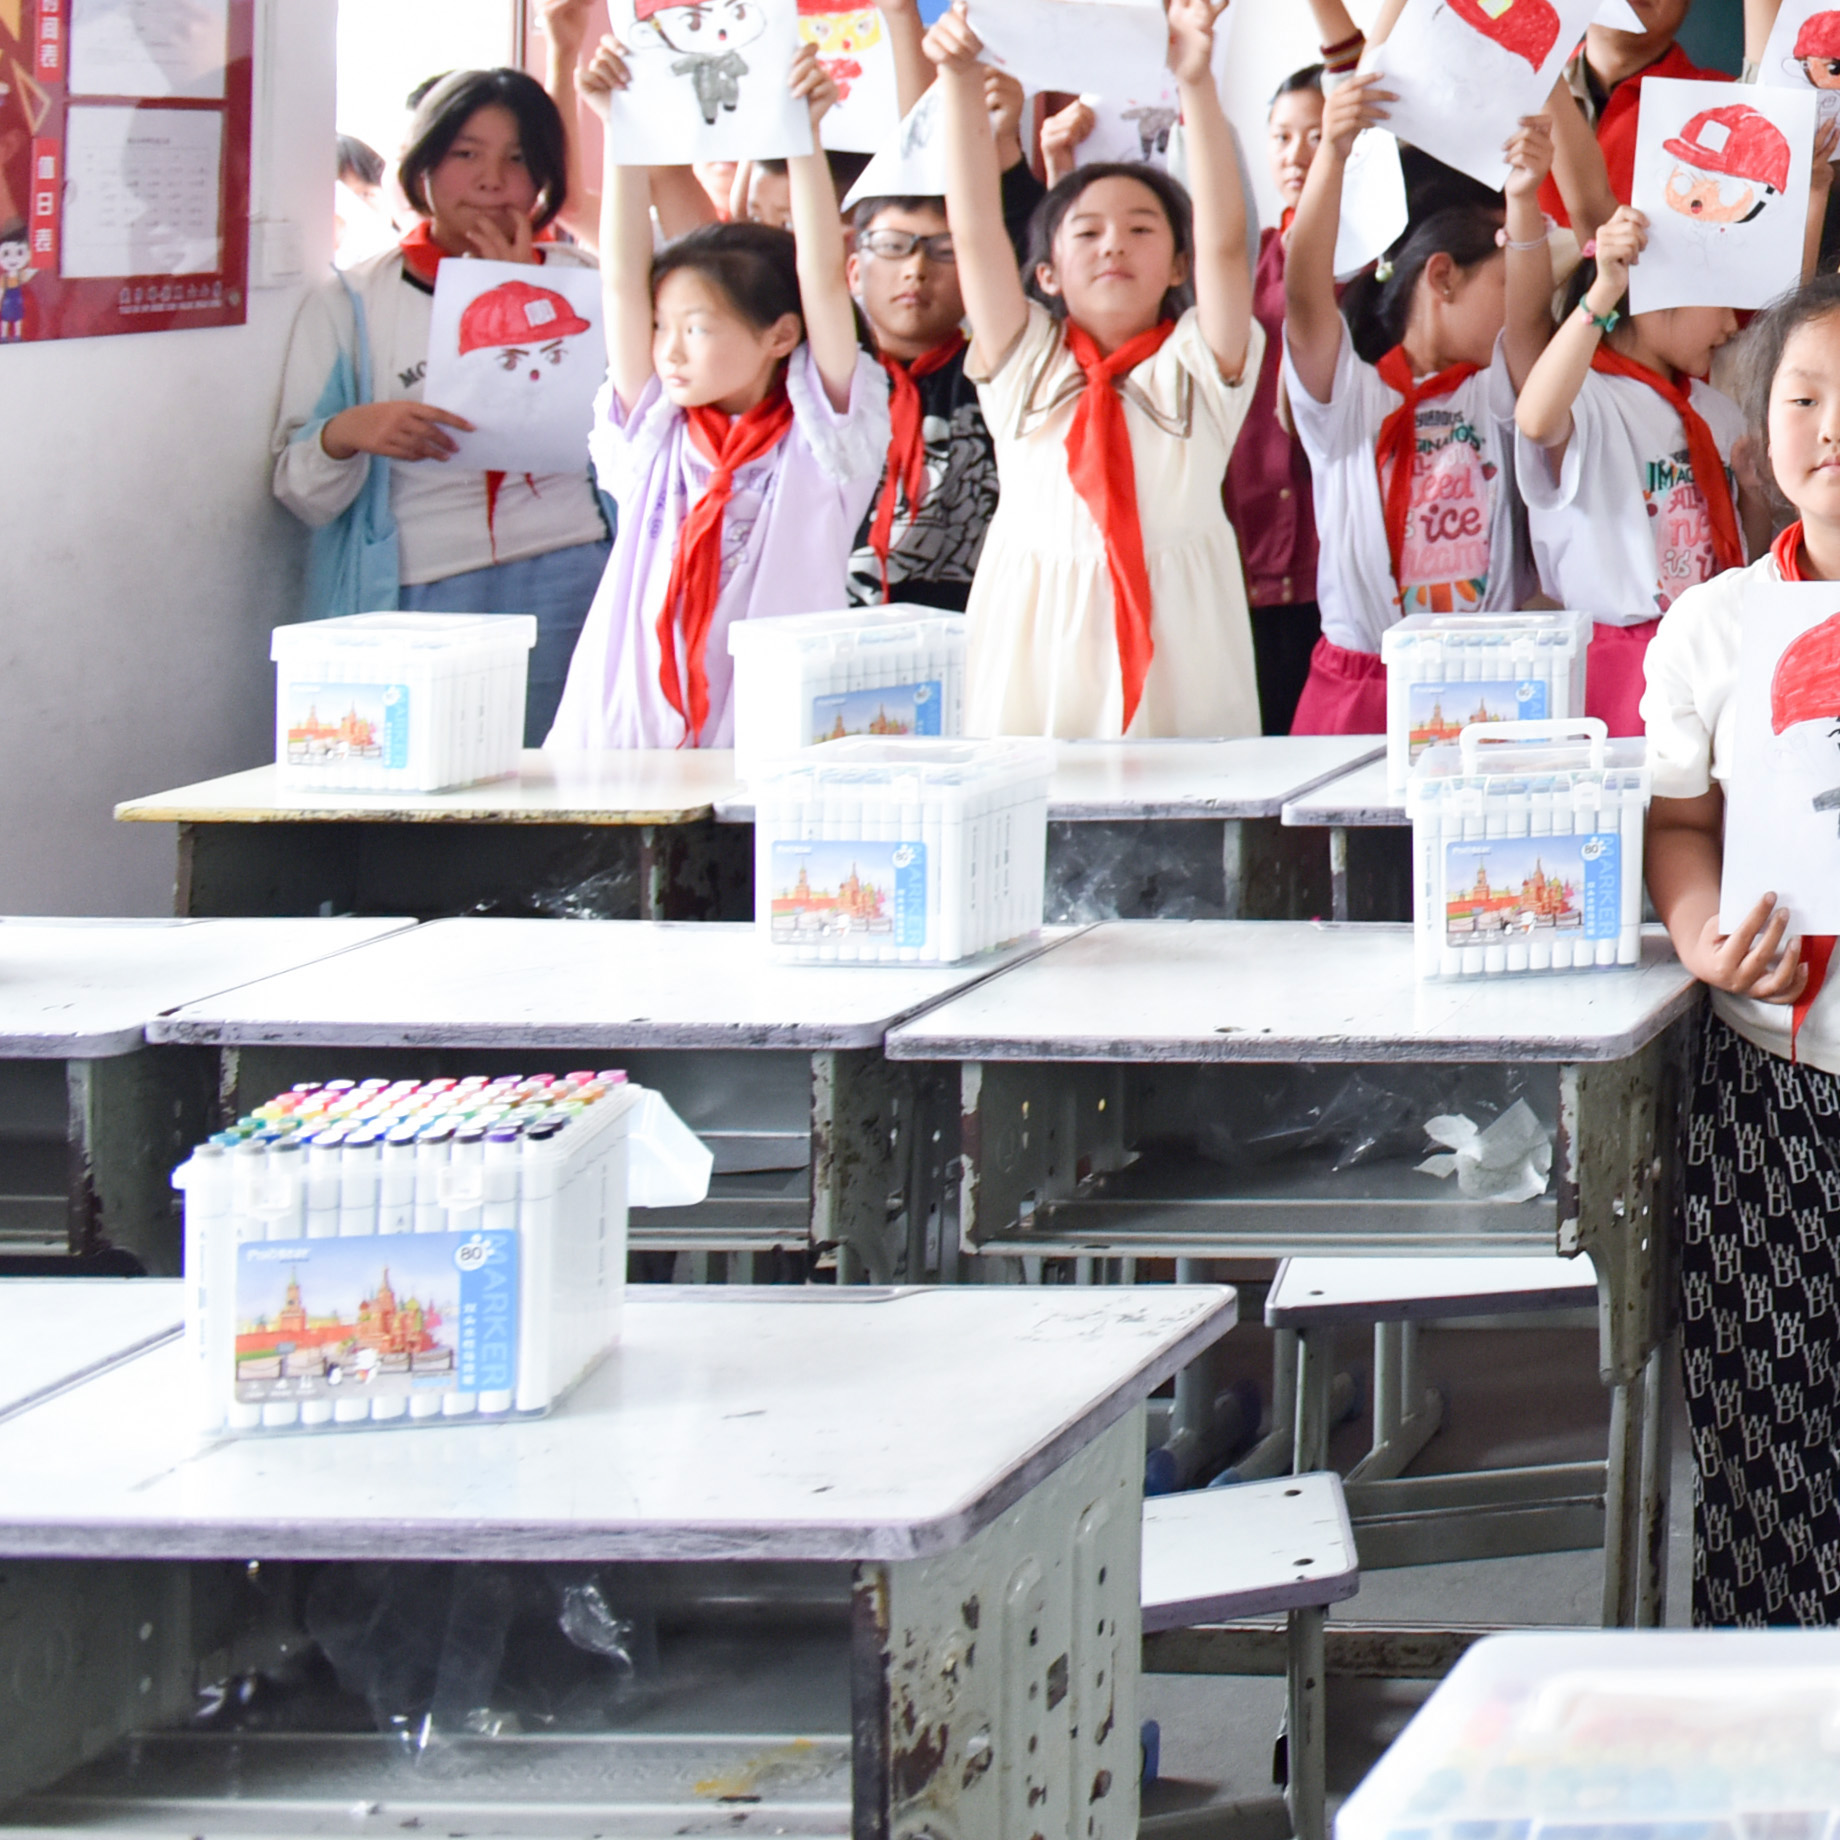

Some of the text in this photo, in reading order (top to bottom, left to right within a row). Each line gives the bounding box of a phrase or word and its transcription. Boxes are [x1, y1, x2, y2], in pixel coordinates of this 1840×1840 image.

[1420, 504, 1482, 544] ice
[1584, 845, 1599, 854] 80
[1598, 837, 1616, 936] MARKER
[460, 1246, 483, 1261] 80
[481, 1234, 509, 1388] MARKER
